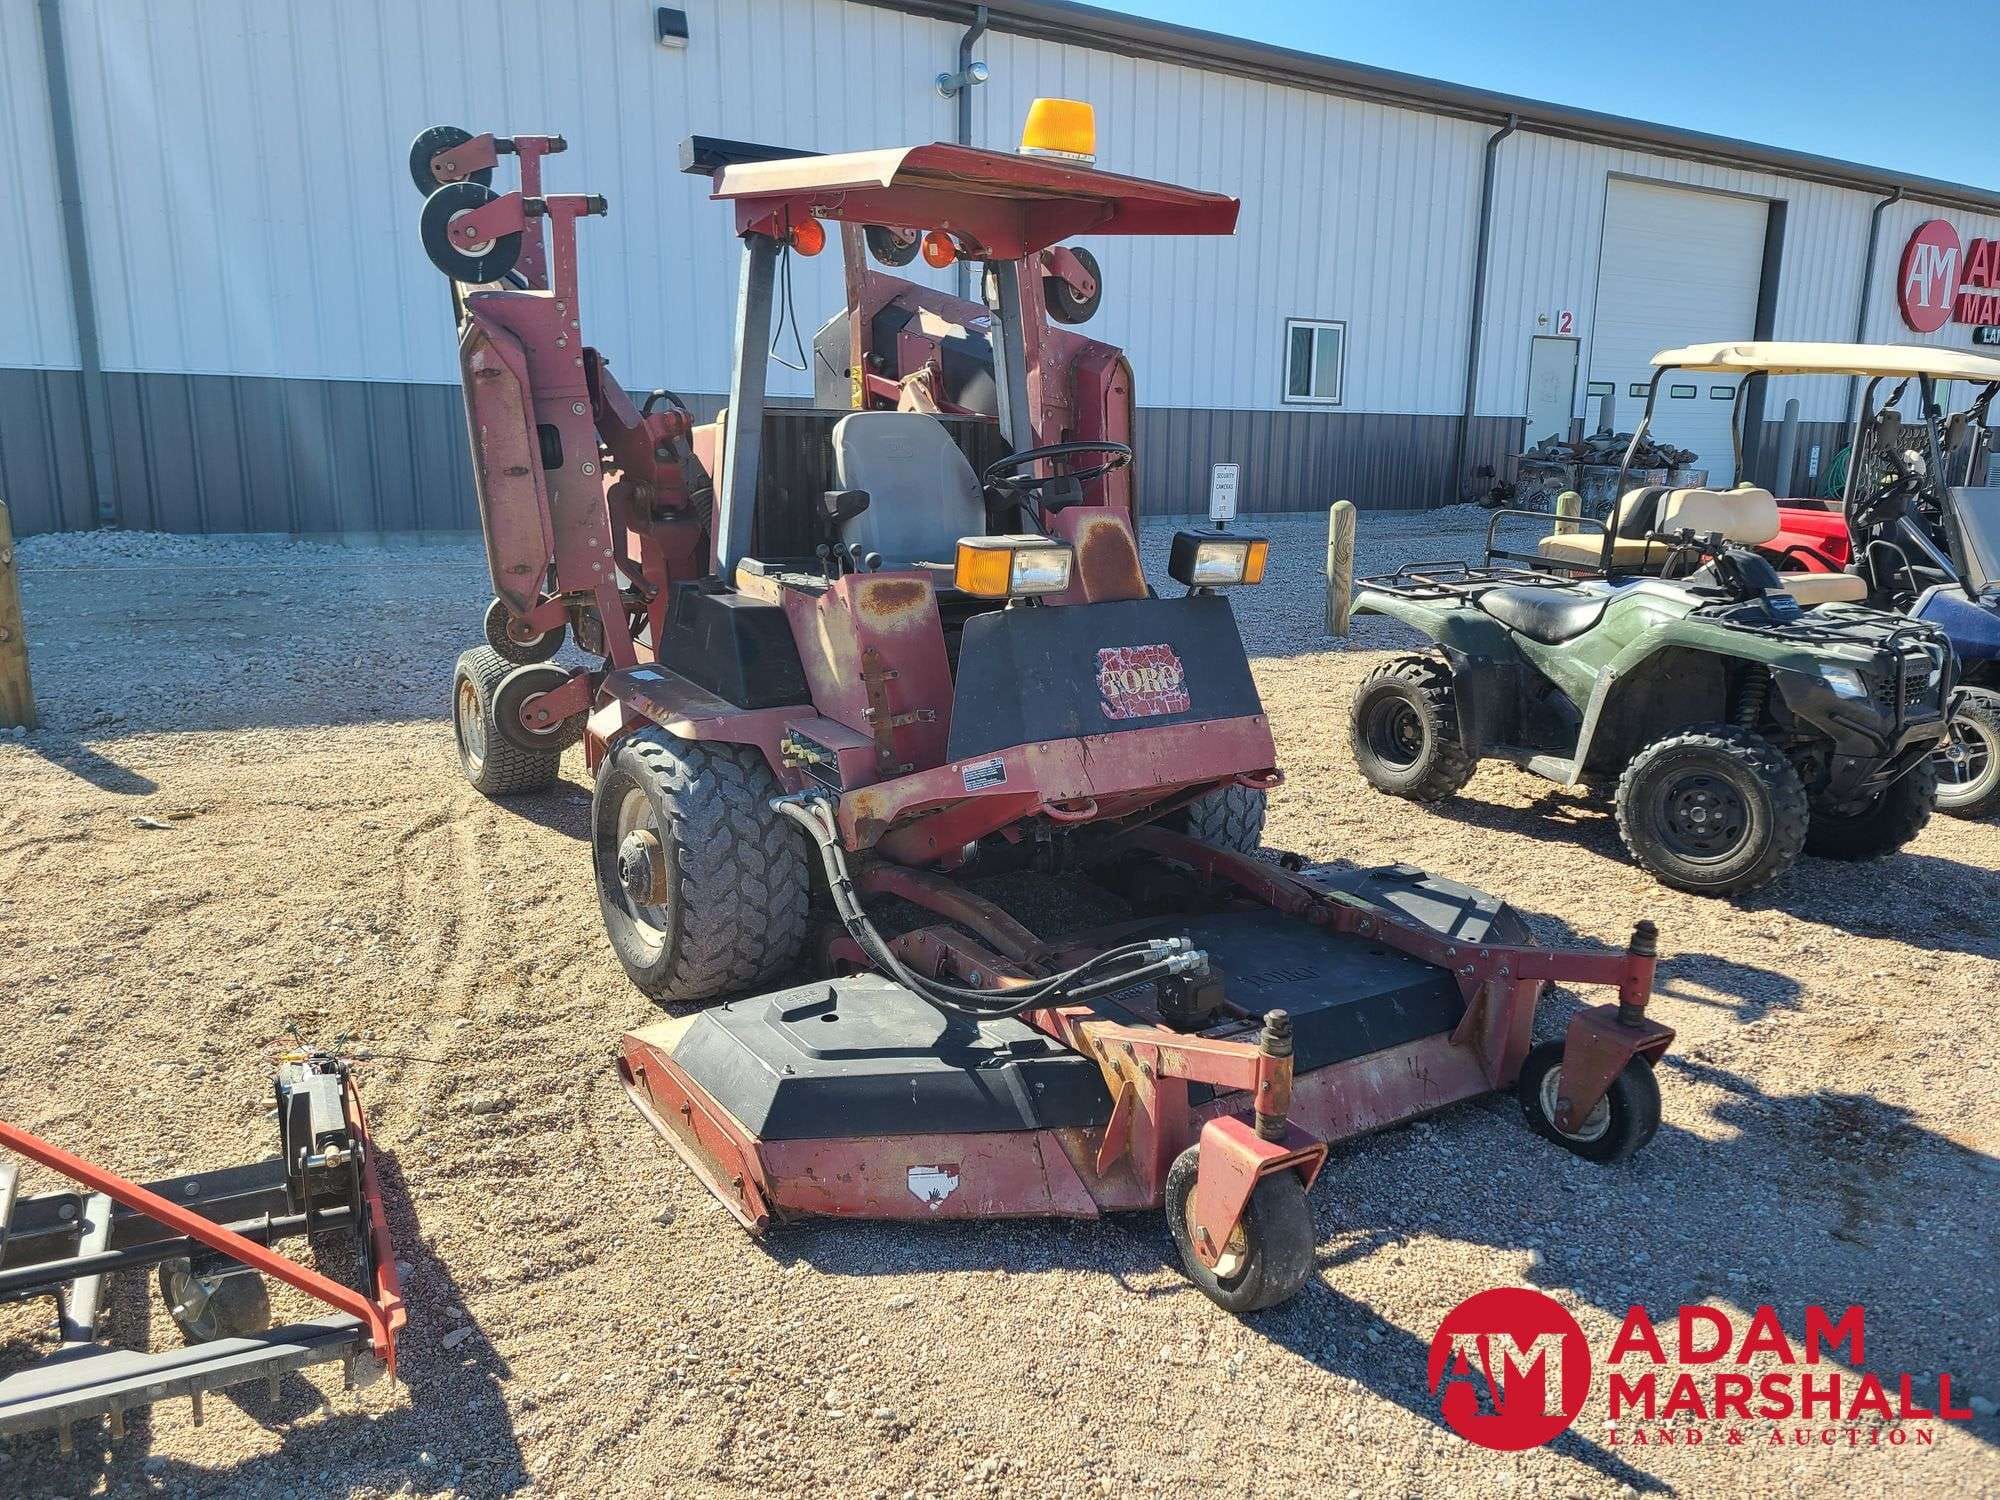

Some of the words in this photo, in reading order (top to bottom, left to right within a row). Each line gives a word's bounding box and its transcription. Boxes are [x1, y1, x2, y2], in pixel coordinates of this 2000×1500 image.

[1905, 243, 1958, 309] AM
[1560, 312, 1571, 333] 2
[1103, 664, 1181, 698] TORO
